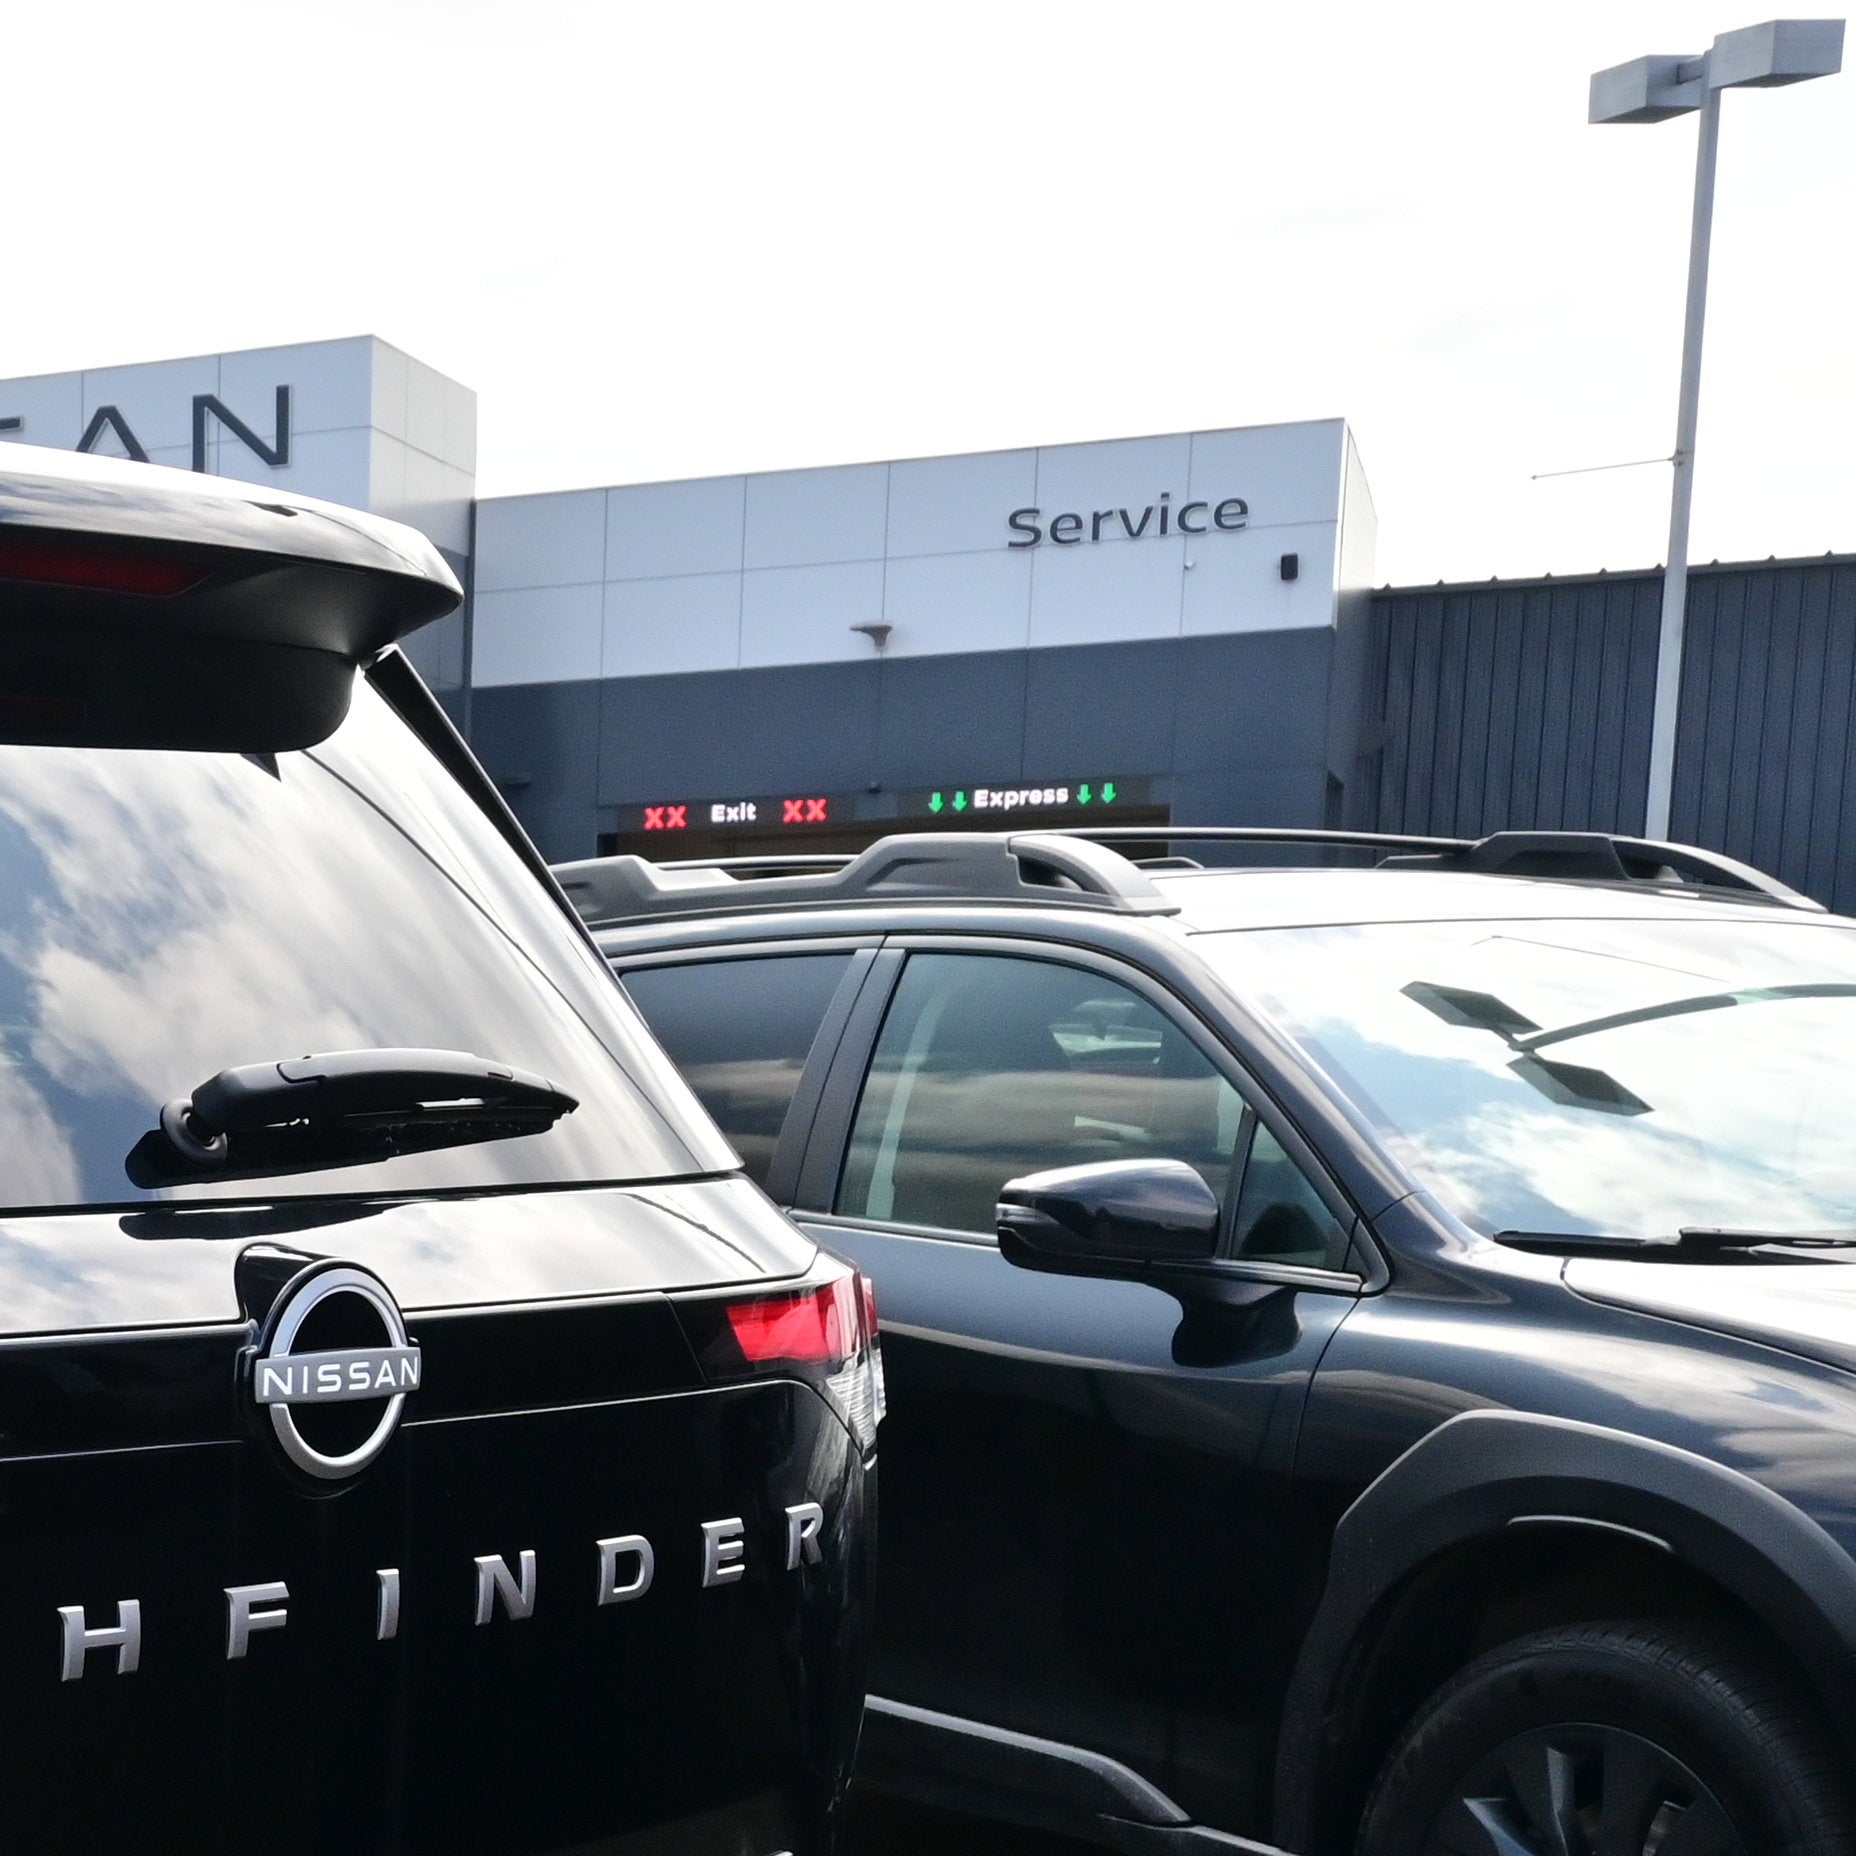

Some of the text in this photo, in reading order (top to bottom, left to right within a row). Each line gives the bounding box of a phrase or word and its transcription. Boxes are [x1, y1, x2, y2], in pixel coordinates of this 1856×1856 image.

[1007, 491, 1249, 549] Service
[711, 803, 757, 823] Exit
[974, 787, 1070, 809] Express
[262, 1356, 419, 1397] NISSAN
